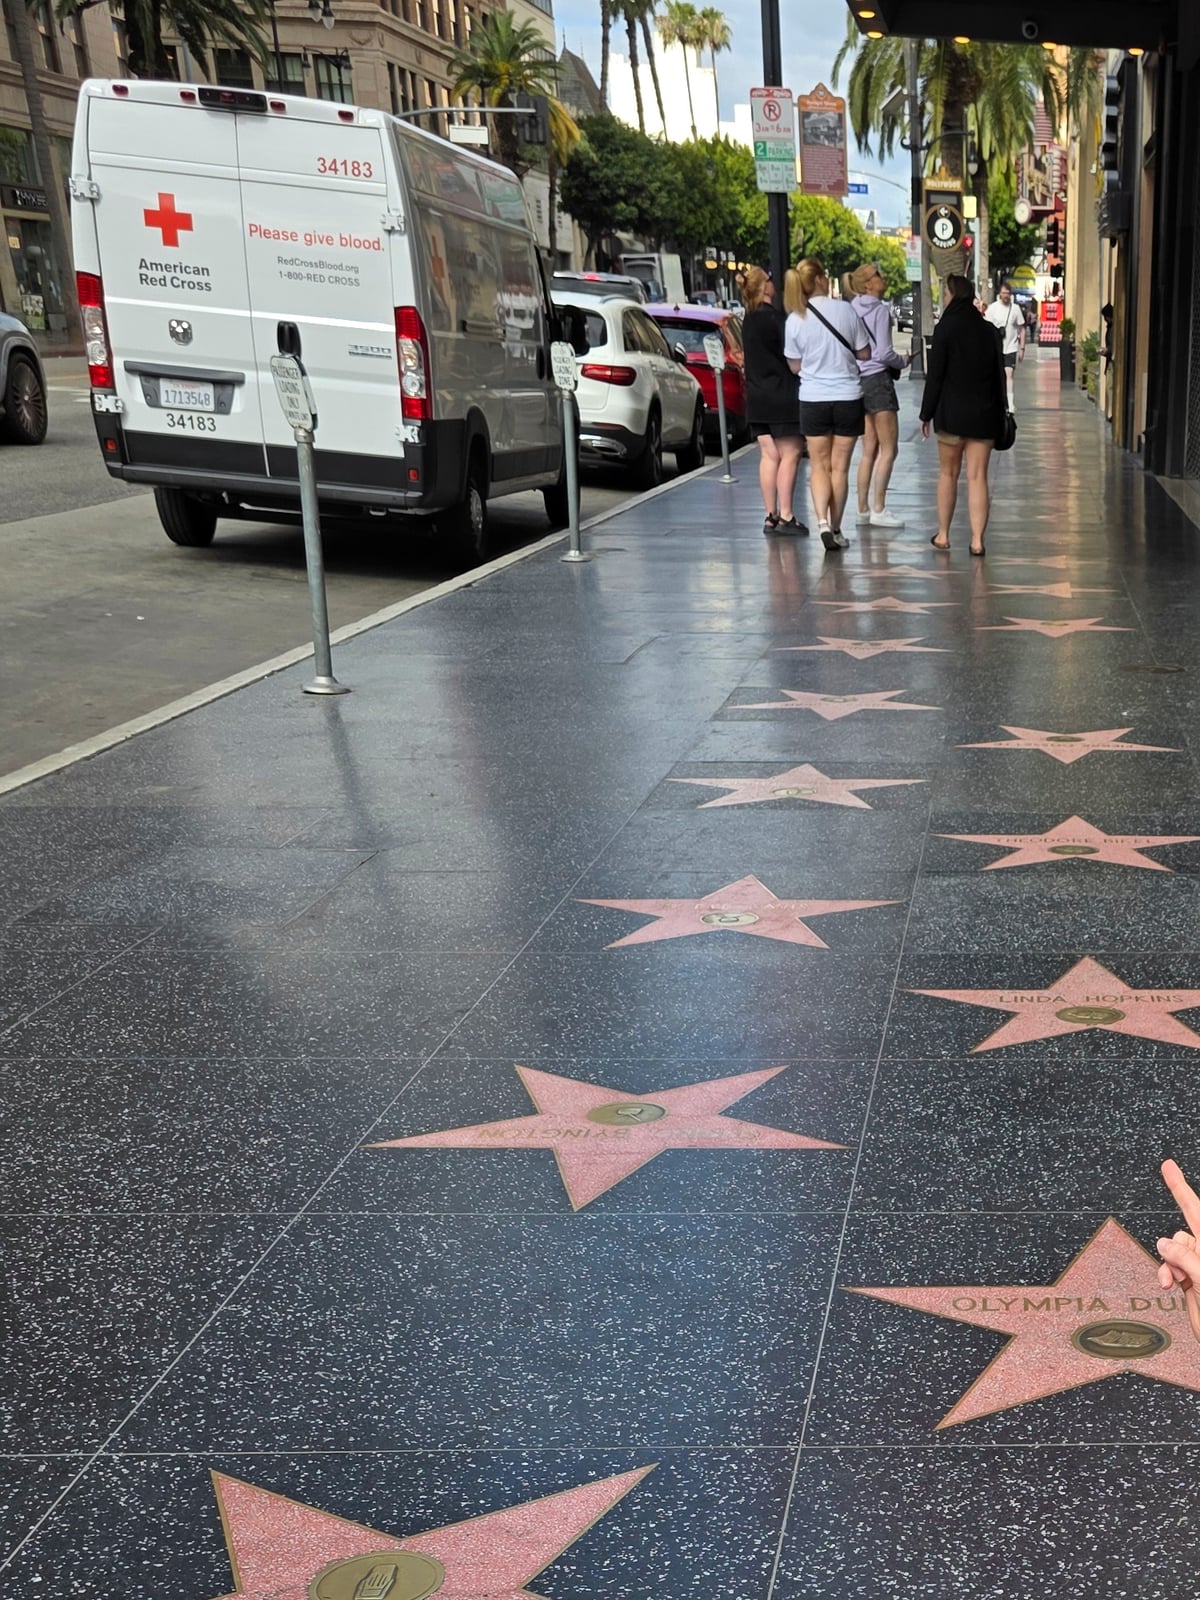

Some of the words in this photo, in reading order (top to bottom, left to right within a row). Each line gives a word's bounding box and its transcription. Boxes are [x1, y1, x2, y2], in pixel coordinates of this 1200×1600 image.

[756, 142, 765, 156] 2
[317, 157, 373, 178] 34183
[248, 223, 299, 242] Please
[303, 230, 334, 246] give
[339, 233, 385, 252] blood.
[941, 222, 949, 236] P
[139, 258, 211, 277] American
[277, 256, 359, 274] RedCrossBlood.org
[139, 272, 167, 287] Red
[170, 276, 212, 292] Cross
[279, 270, 326, 284] 1-800-RED
[328, 275, 361, 287] CROSS
[164, 389, 211, 407] 1713548
[166, 412, 217, 432] 34183
[999, 994, 1067, 1004] LINDA
[1085, 993, 1185, 1004] HOPKINS
[478, 1127, 630, 1140] BYINGTON
[950, 1295, 1106, 1314] OLYMPIA
